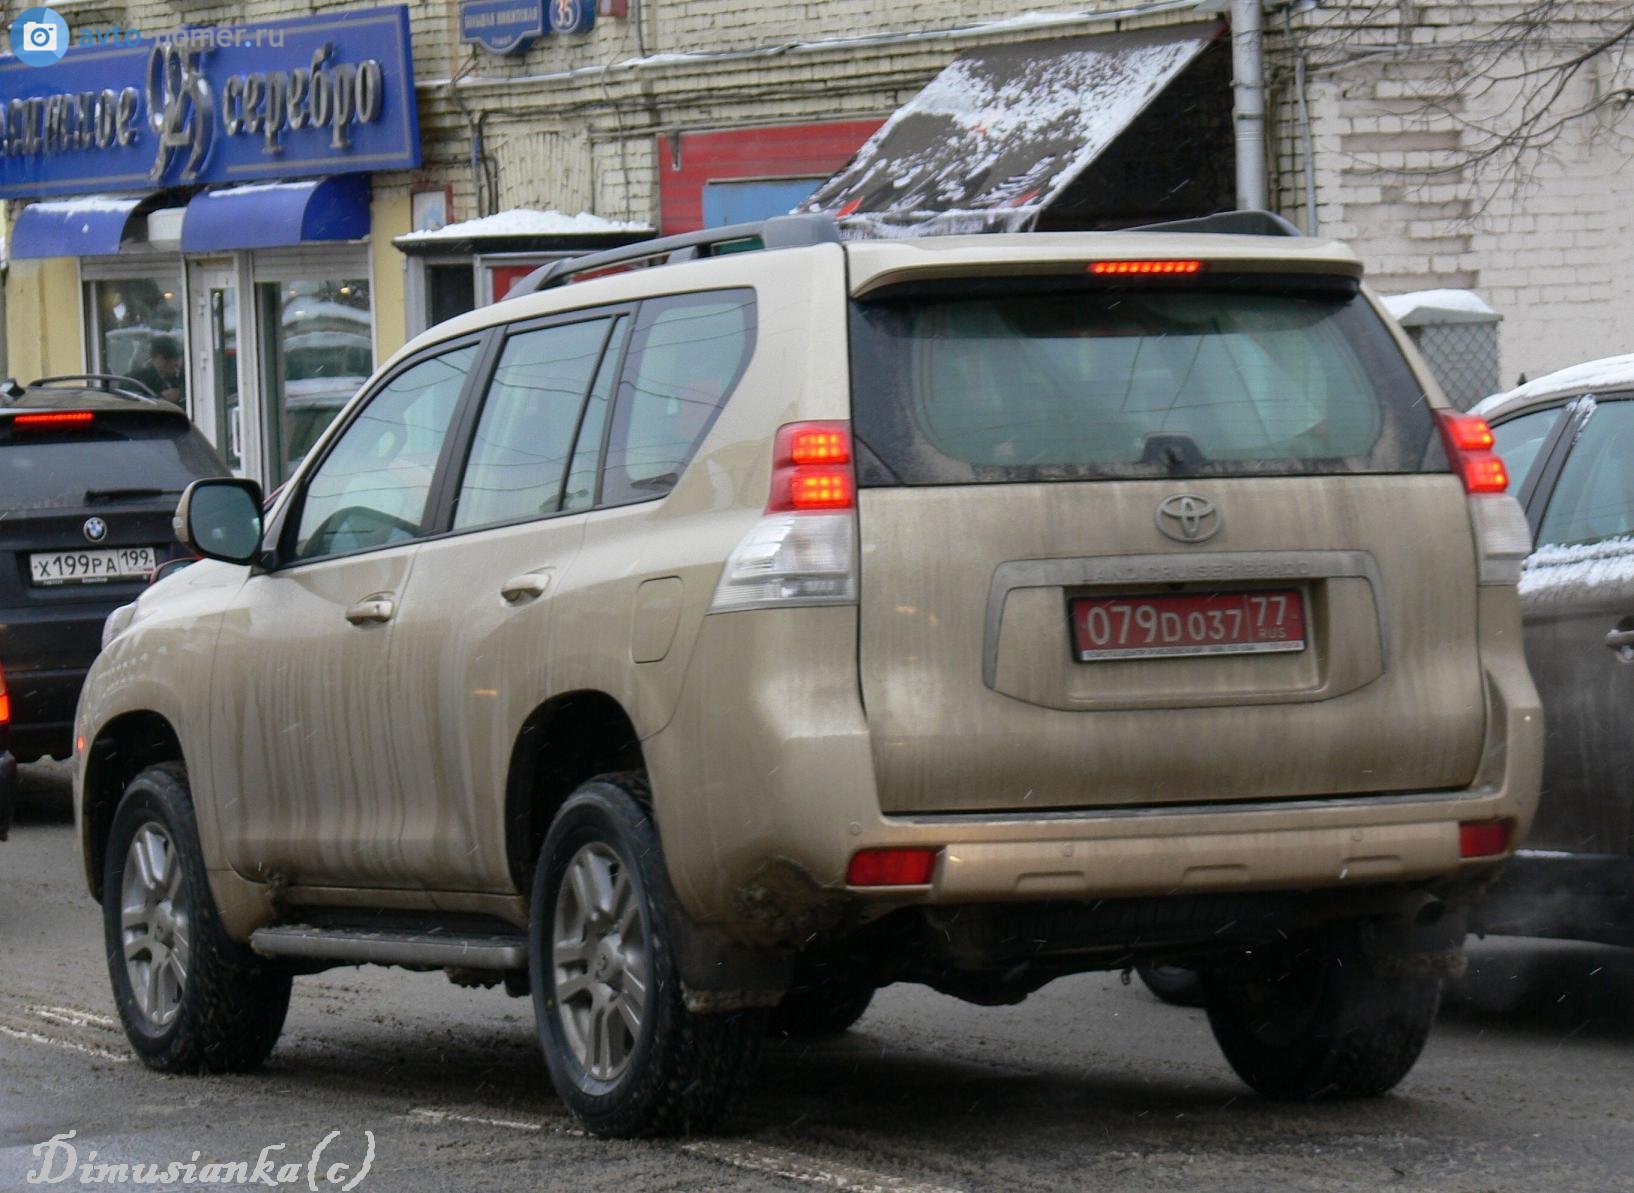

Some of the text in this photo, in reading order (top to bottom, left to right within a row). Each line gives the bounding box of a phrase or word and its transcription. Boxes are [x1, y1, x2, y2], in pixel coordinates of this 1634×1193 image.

[555, 0, 573, 27] 35
[222, 42, 384, 154] серебро
[121, 549, 149, 567] 199
[1251, 596, 1288, 627] 77
